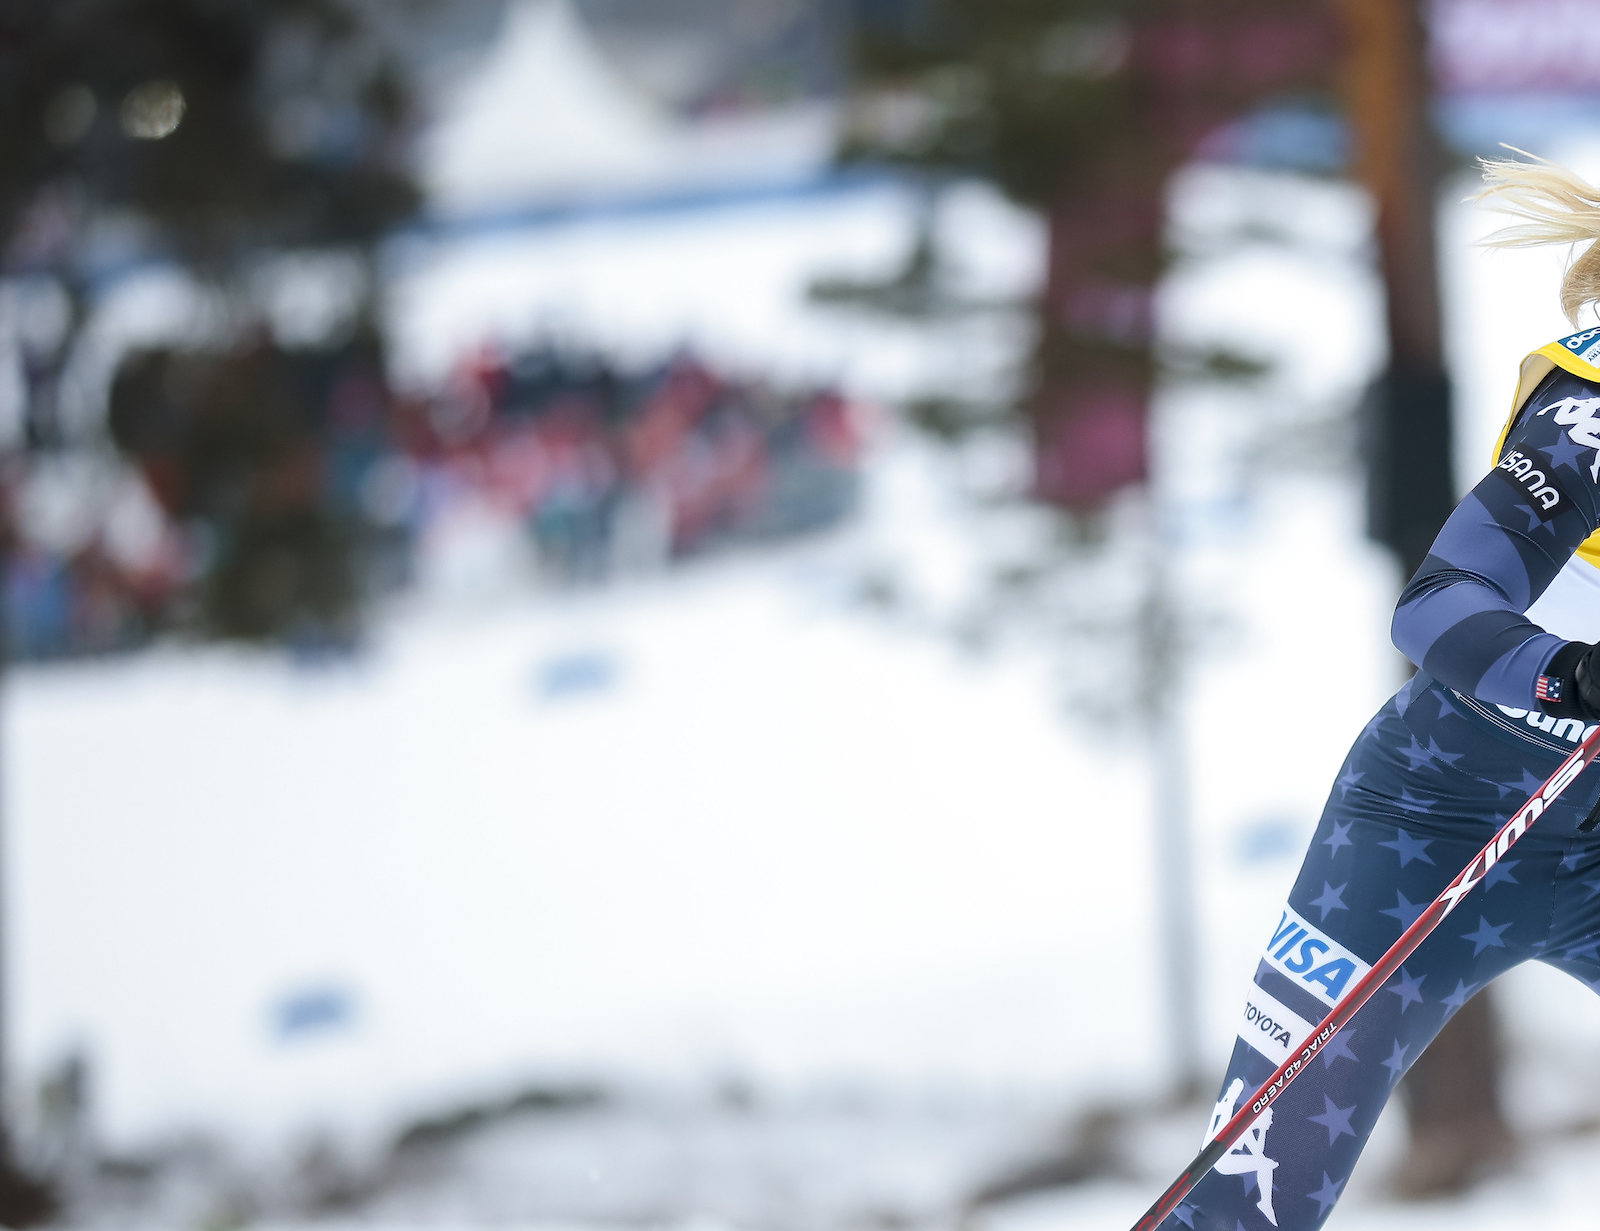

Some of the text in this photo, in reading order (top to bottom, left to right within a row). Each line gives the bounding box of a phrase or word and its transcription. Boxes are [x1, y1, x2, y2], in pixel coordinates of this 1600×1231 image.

[1266, 910, 1358, 1001] VISA
[1243, 1001, 1292, 1049] TOYOTA
[1301, 1022, 1338, 1062] TRIAC
[1252, 1075, 1284, 1114] AERO
